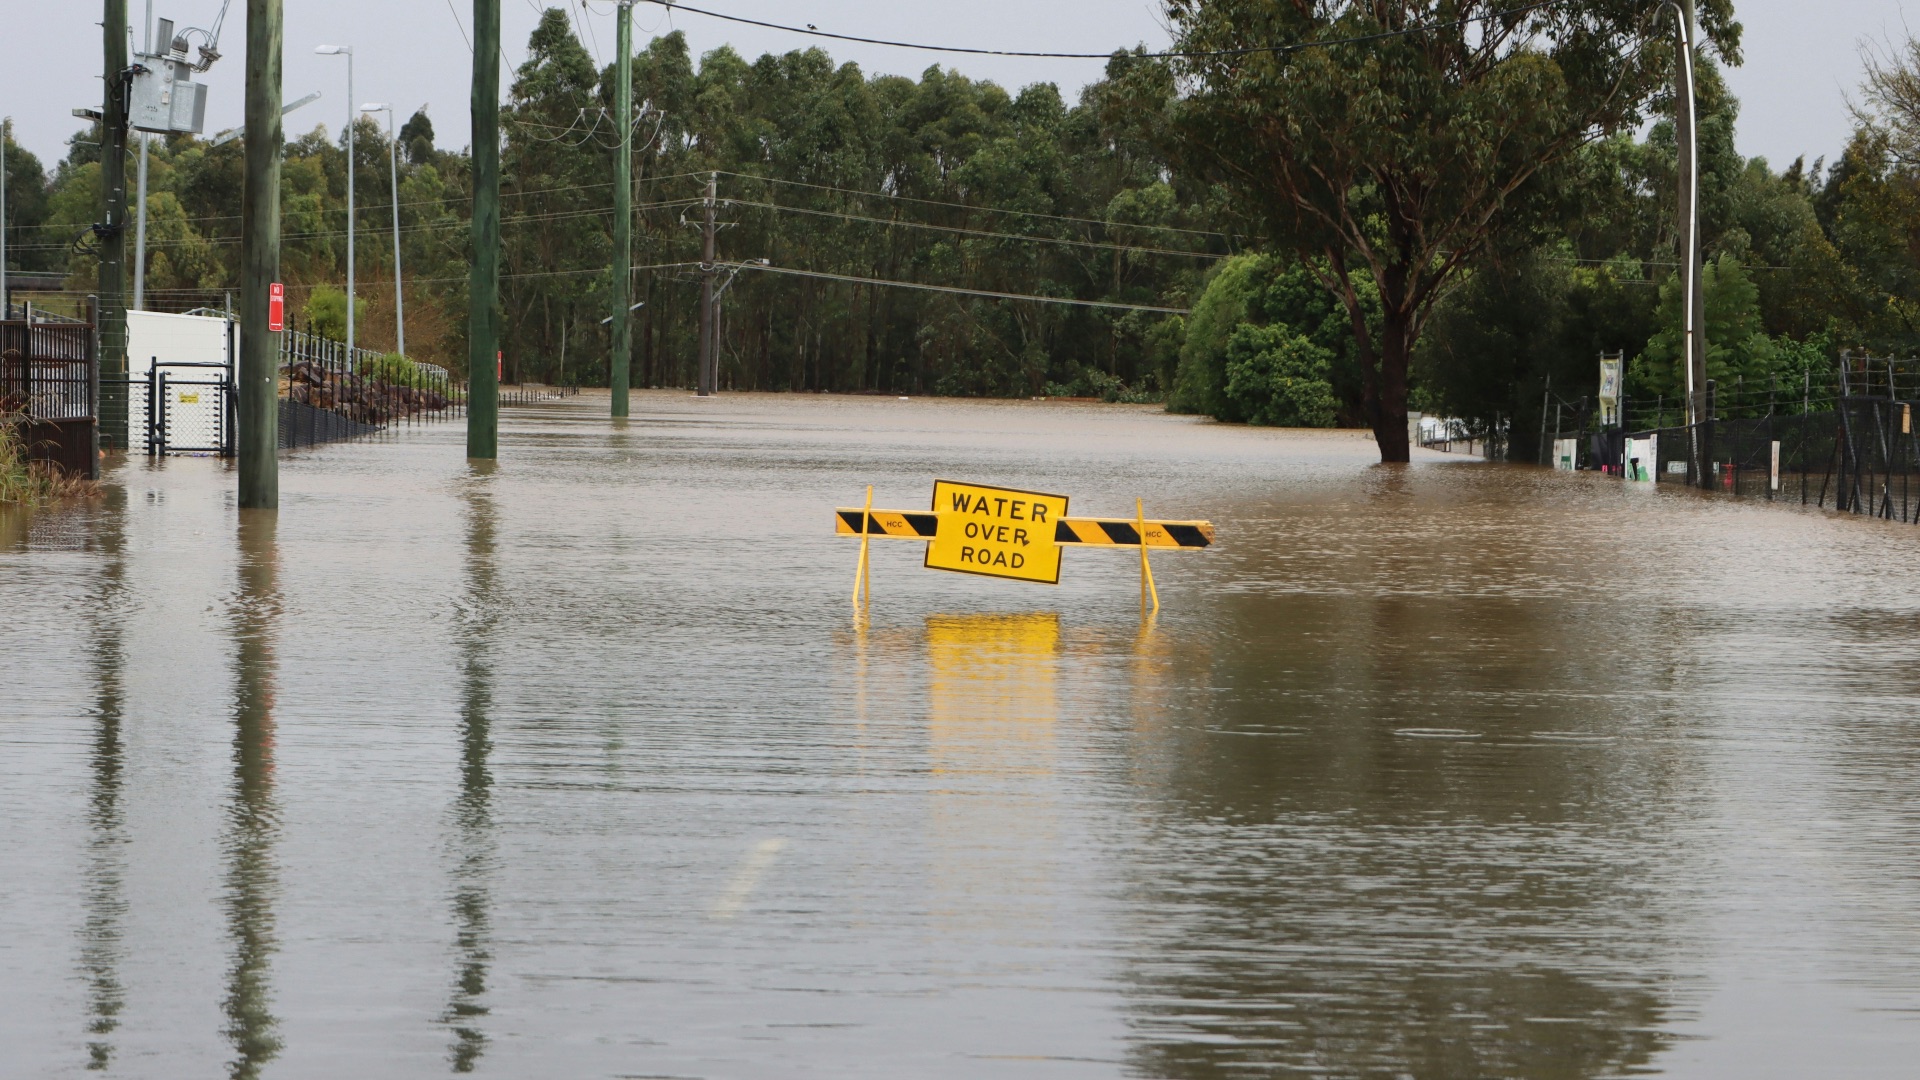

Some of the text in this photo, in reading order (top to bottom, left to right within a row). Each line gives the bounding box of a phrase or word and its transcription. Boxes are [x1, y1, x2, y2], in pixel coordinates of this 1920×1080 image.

[952, 492, 1048, 523] WATER
[964, 522, 1028, 545] OVER
[960, 546, 1025, 569] ROAD
